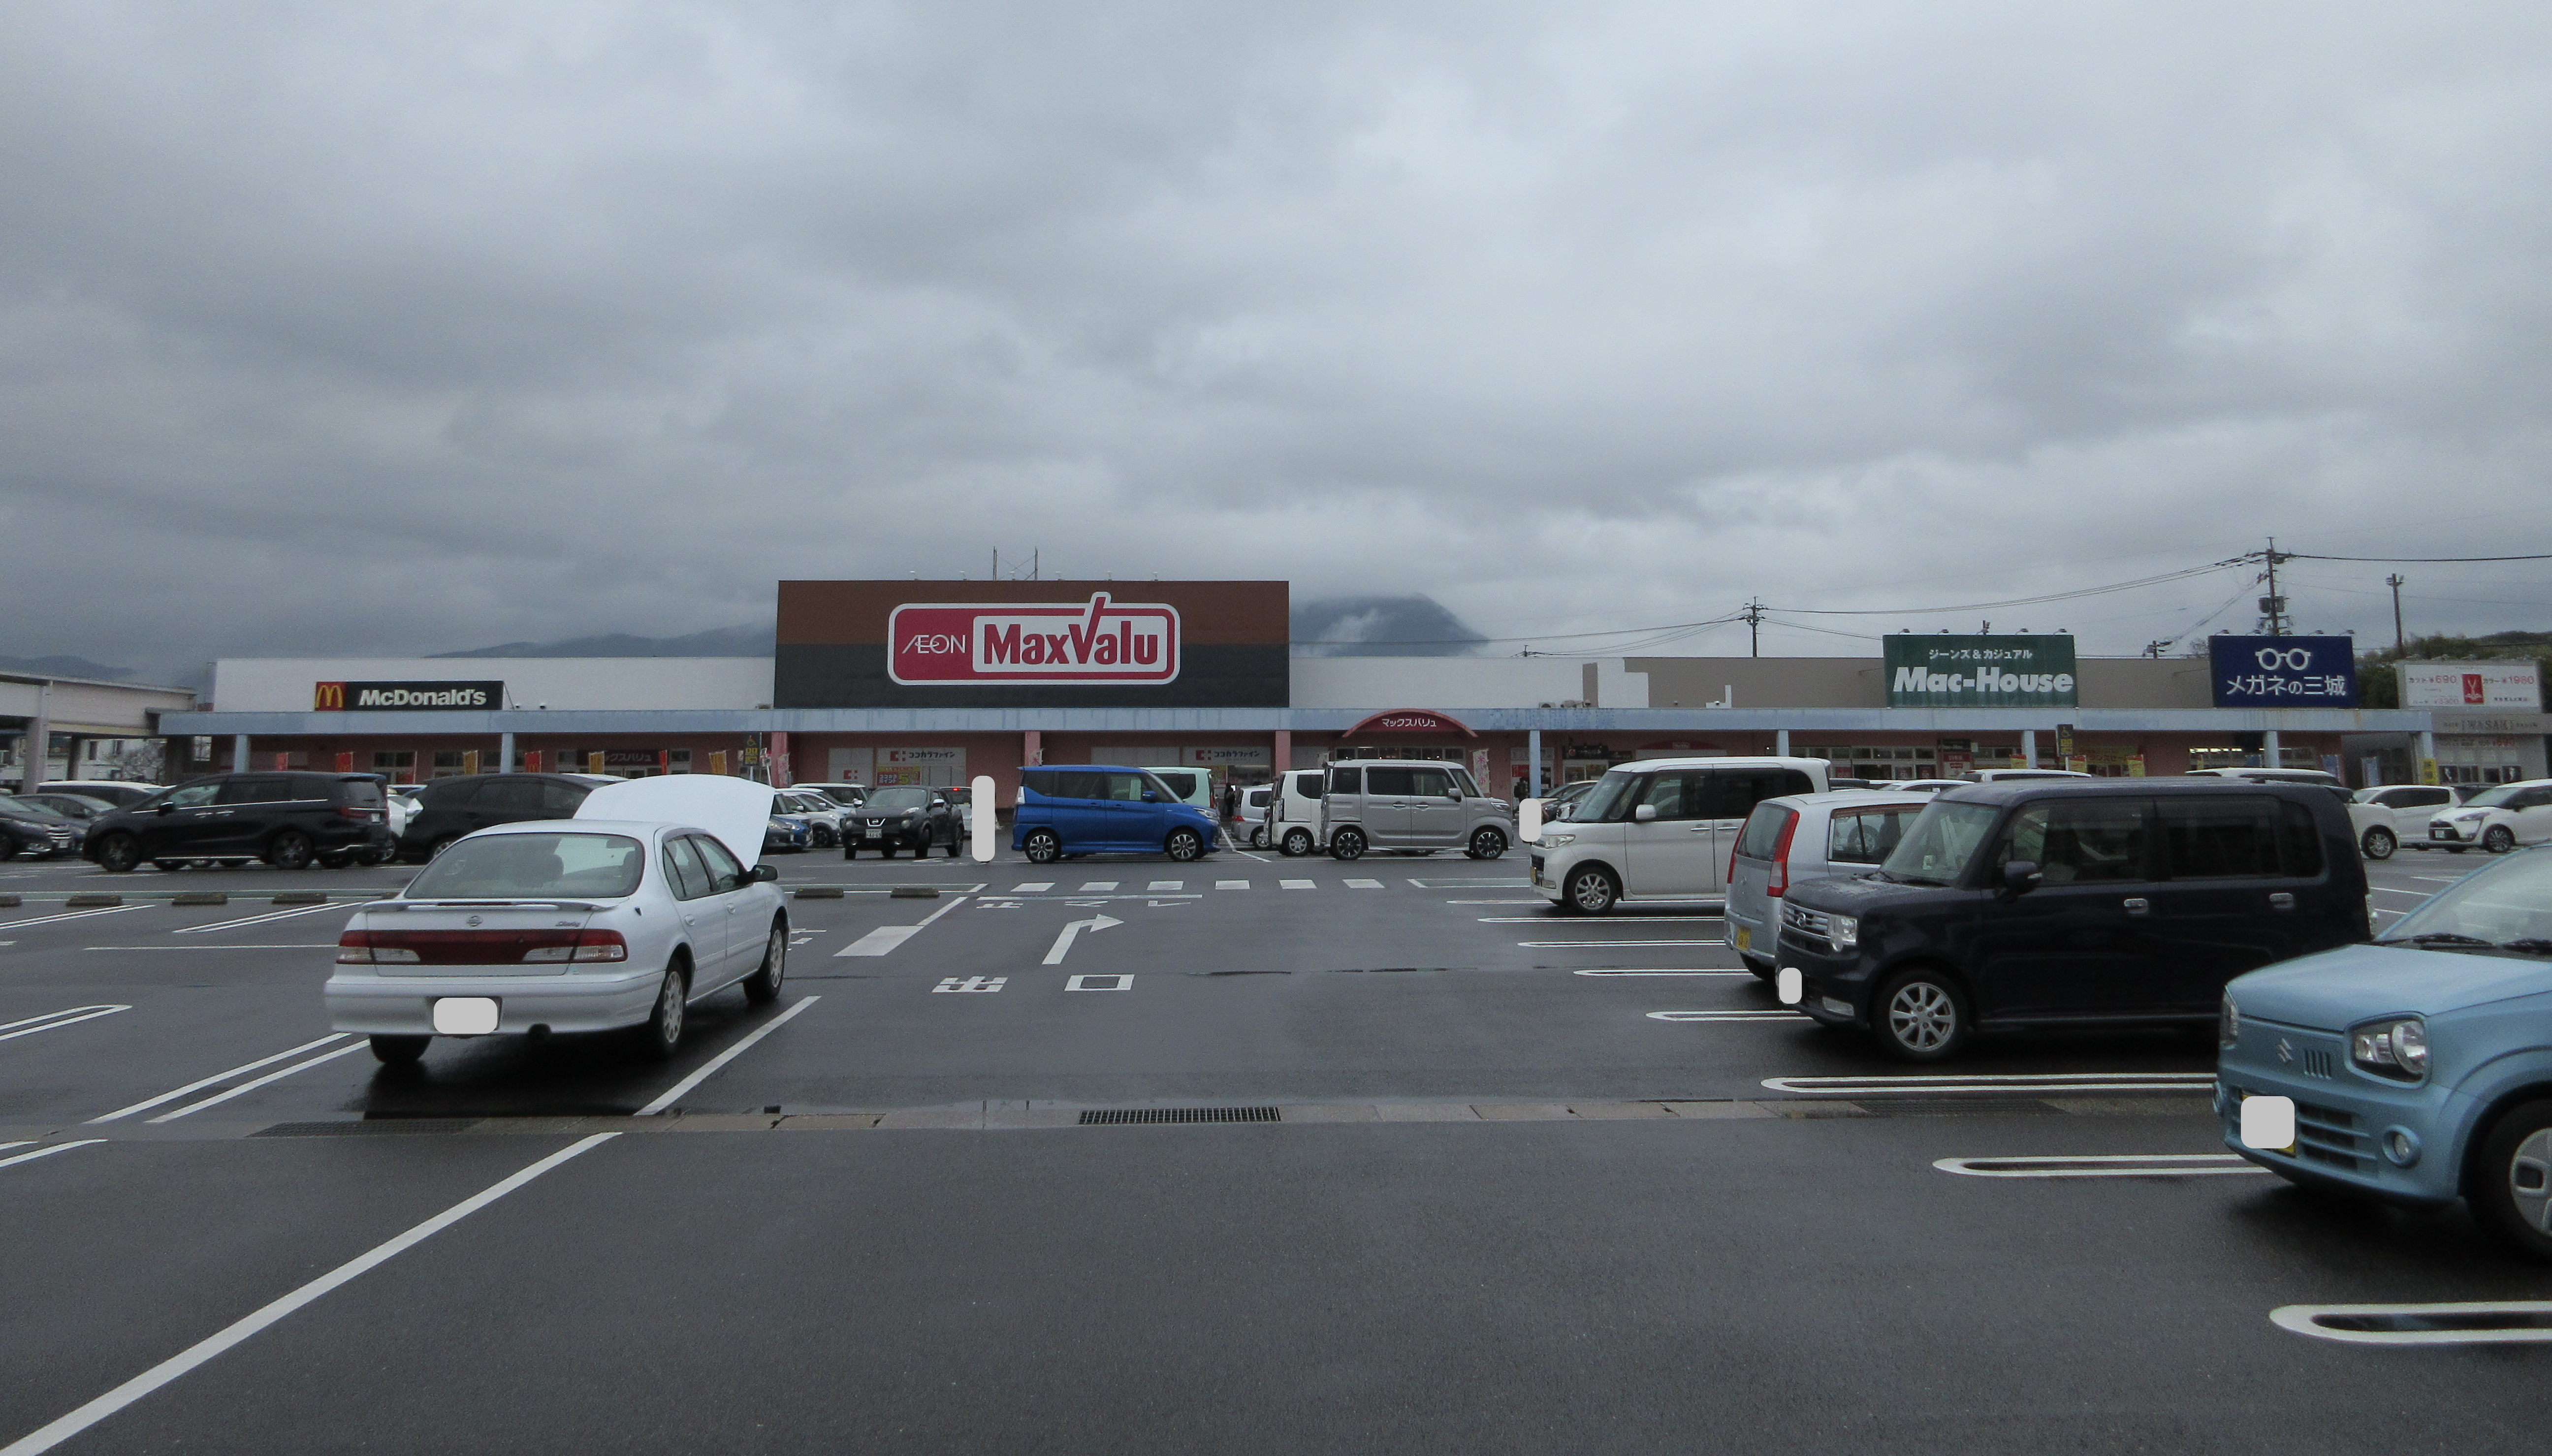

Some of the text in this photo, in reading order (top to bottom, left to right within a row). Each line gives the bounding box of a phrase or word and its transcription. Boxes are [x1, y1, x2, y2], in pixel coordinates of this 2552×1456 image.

[984, 597, 1158, 665] MaxValu
[1893, 666, 2074, 693] Mac-House
[2226, 675, 2347, 696] メガネの三城
[358, 689, 487, 706] McDonald's
[1381, 718, 1437, 727] マックスバリュ
